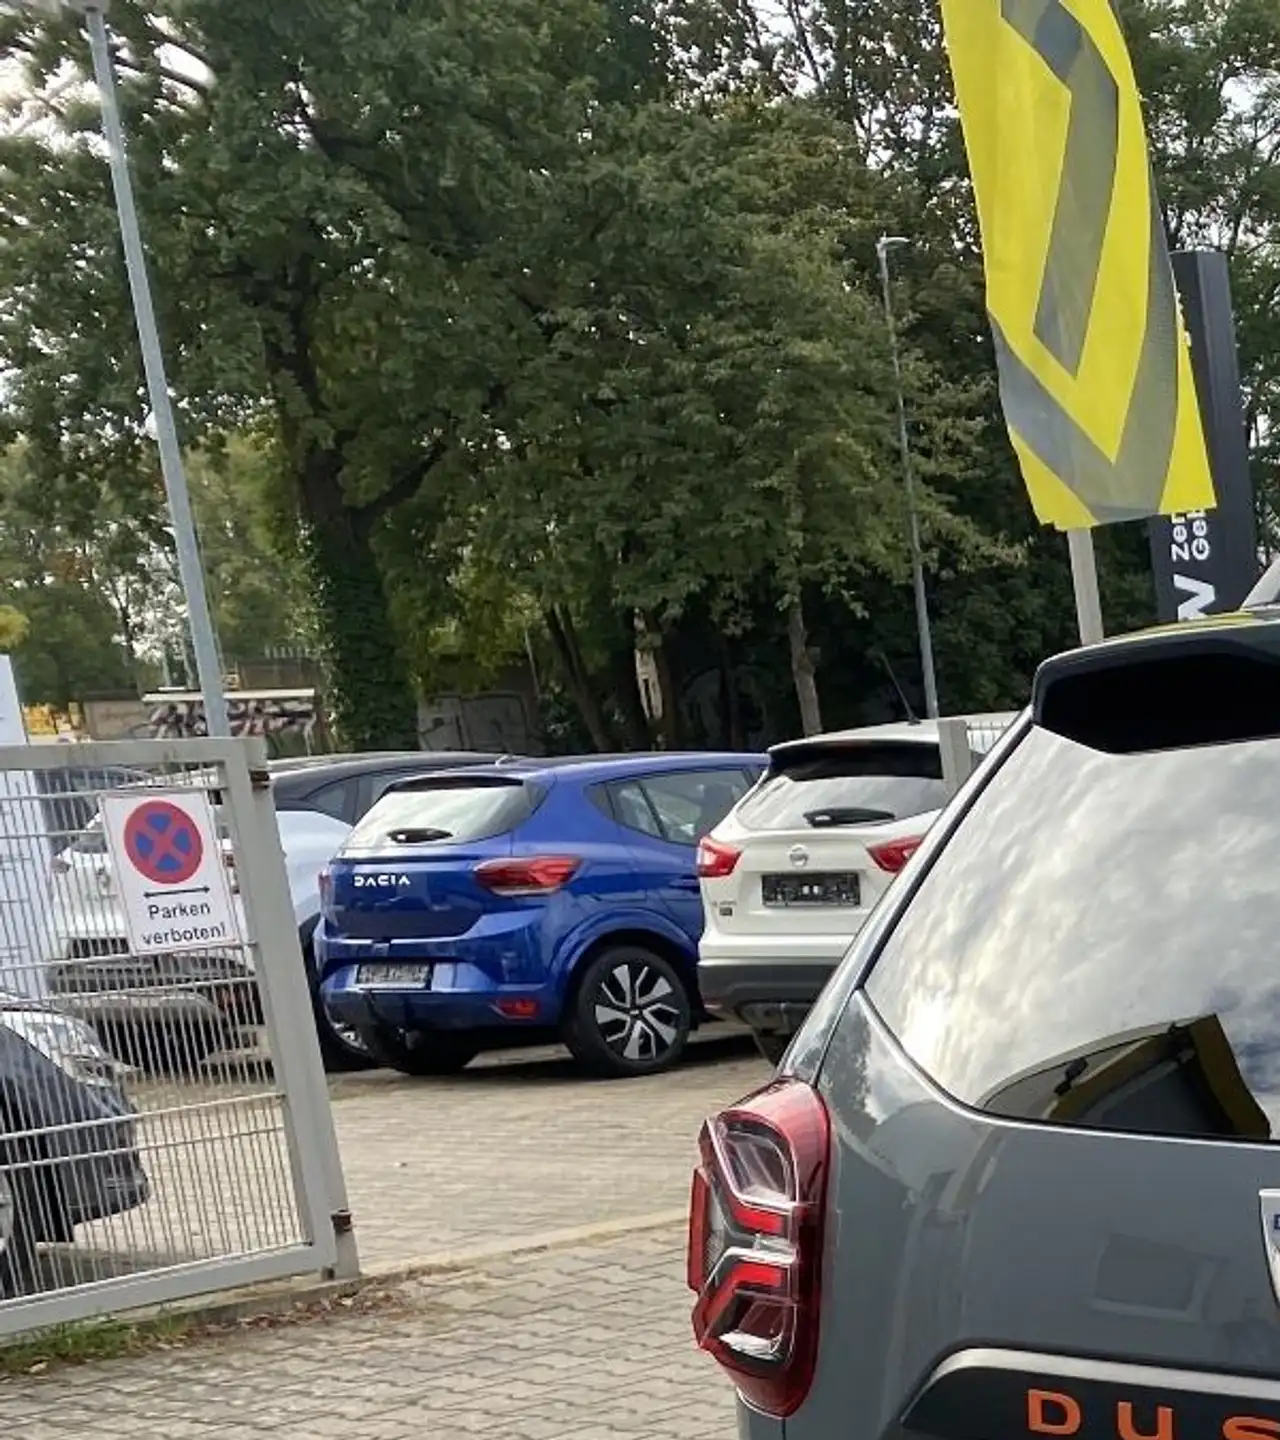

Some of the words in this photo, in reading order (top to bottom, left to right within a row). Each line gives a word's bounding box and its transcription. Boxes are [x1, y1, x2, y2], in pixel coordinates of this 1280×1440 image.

[354, 874, 411, 887] DACIA
[148, 902, 211, 920] Parken
[142, 922, 227, 945] verboten!
